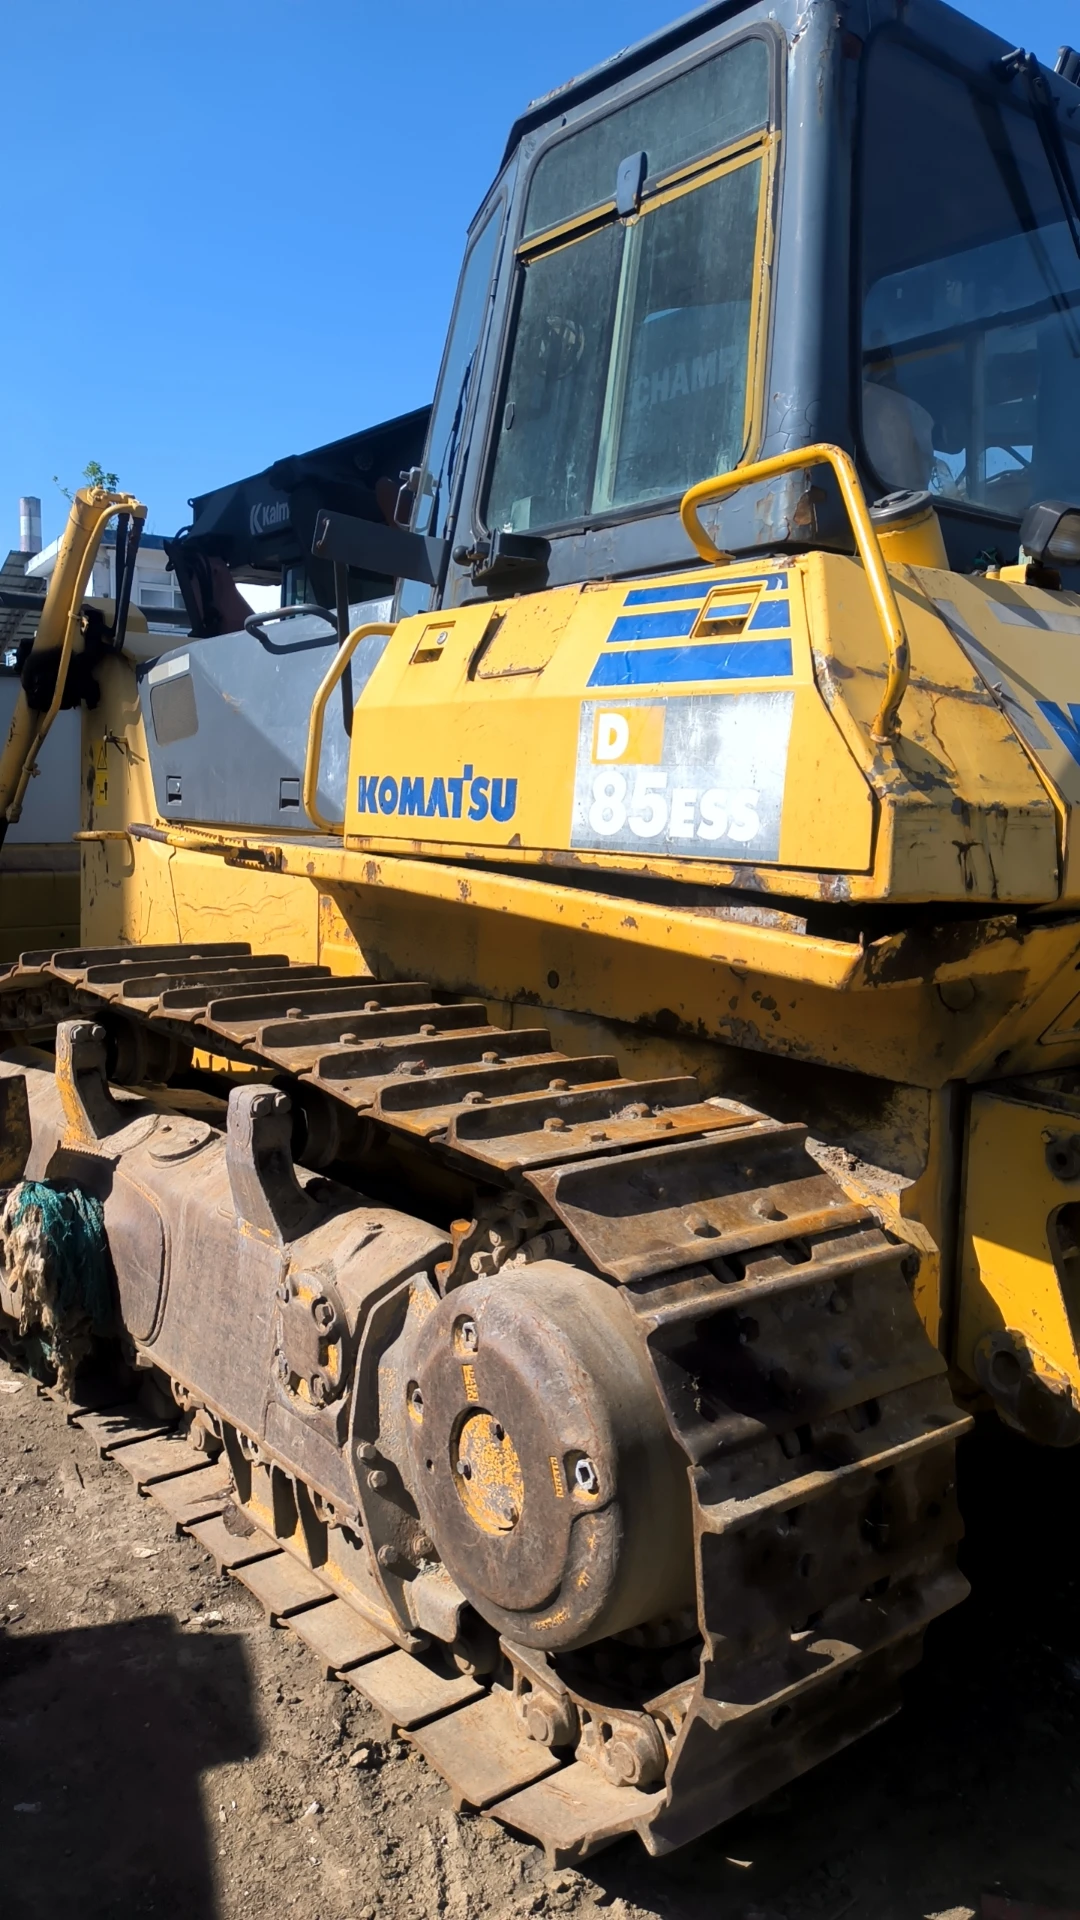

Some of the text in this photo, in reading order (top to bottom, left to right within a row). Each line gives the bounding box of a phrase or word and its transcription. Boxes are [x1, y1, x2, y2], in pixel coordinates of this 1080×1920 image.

[595, 713, 629, 760] D
[358, 764, 518, 822] KOMATSU
[588, 770, 761, 842] 85ESS
